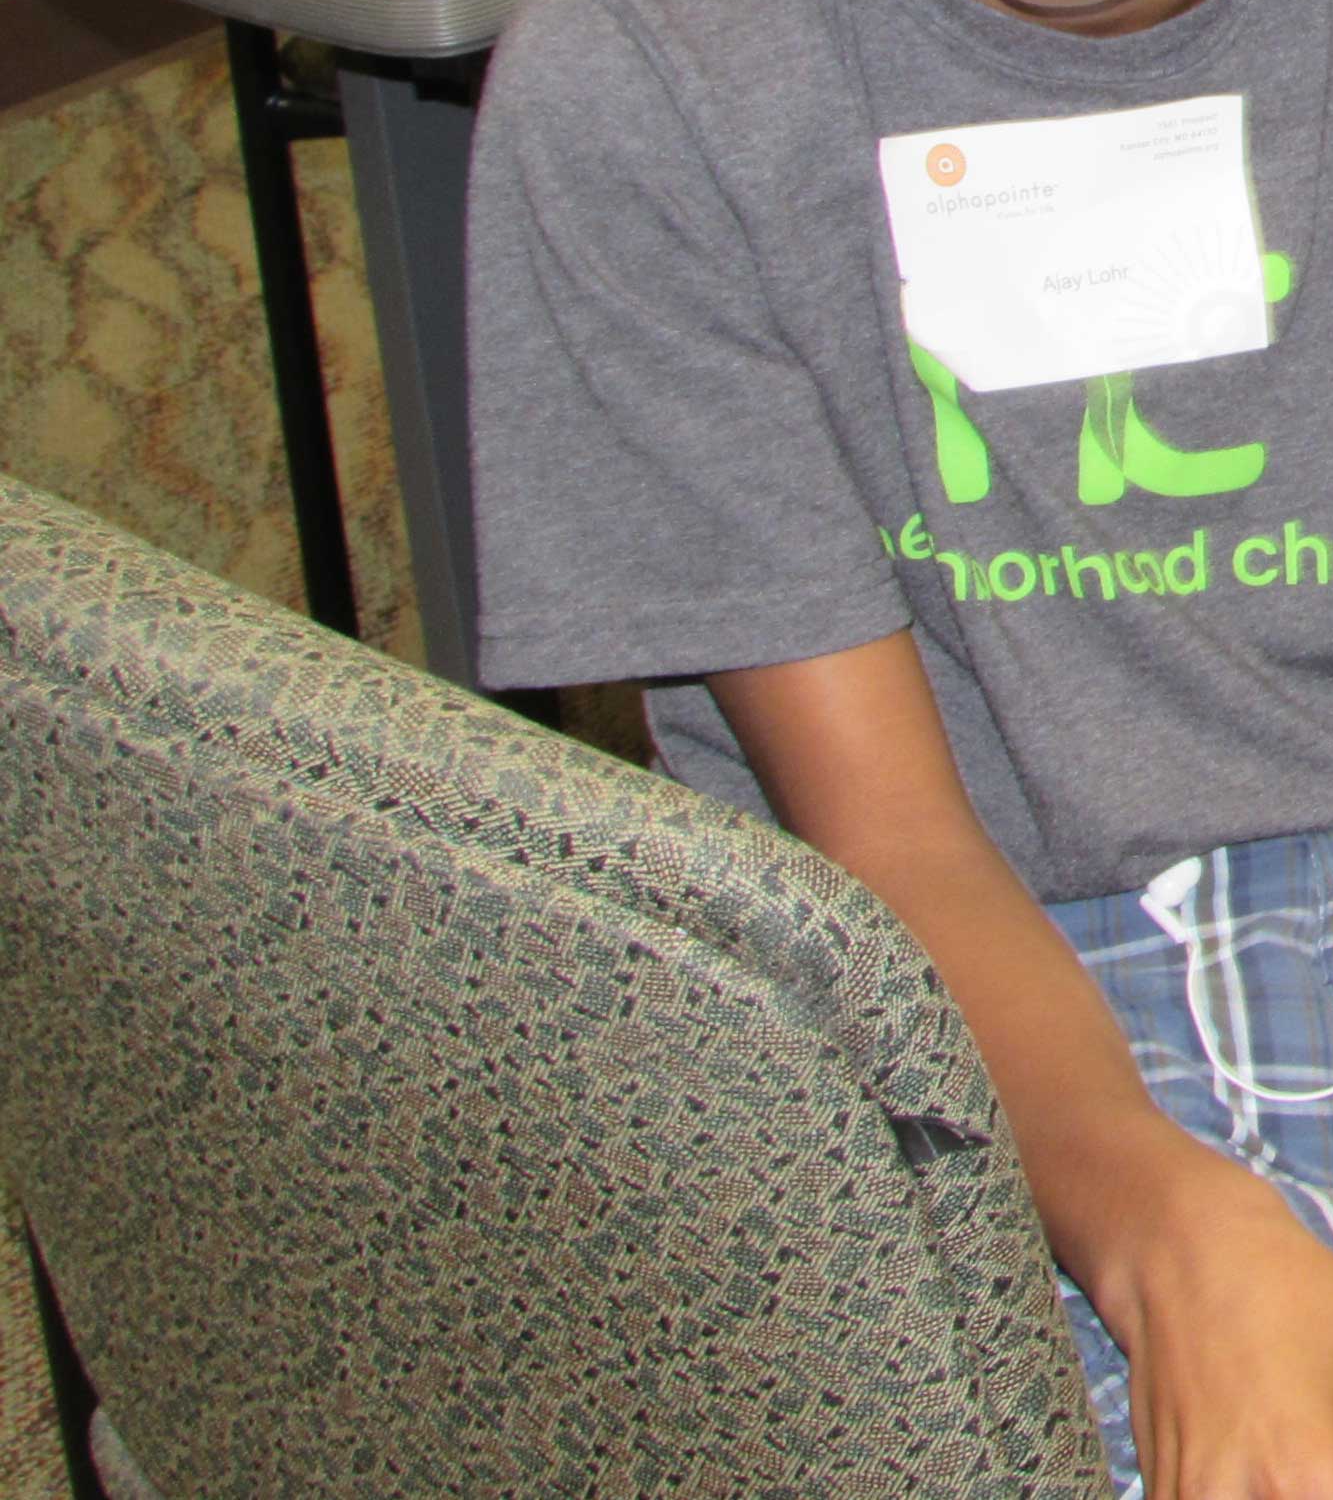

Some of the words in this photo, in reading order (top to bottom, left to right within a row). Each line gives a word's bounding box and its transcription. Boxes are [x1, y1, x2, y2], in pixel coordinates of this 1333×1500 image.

[925, 182, 1056, 218] alphapointe
[1042, 270, 1082, 294] Ajay
[1086, 264, 1129, 285] Lohr
